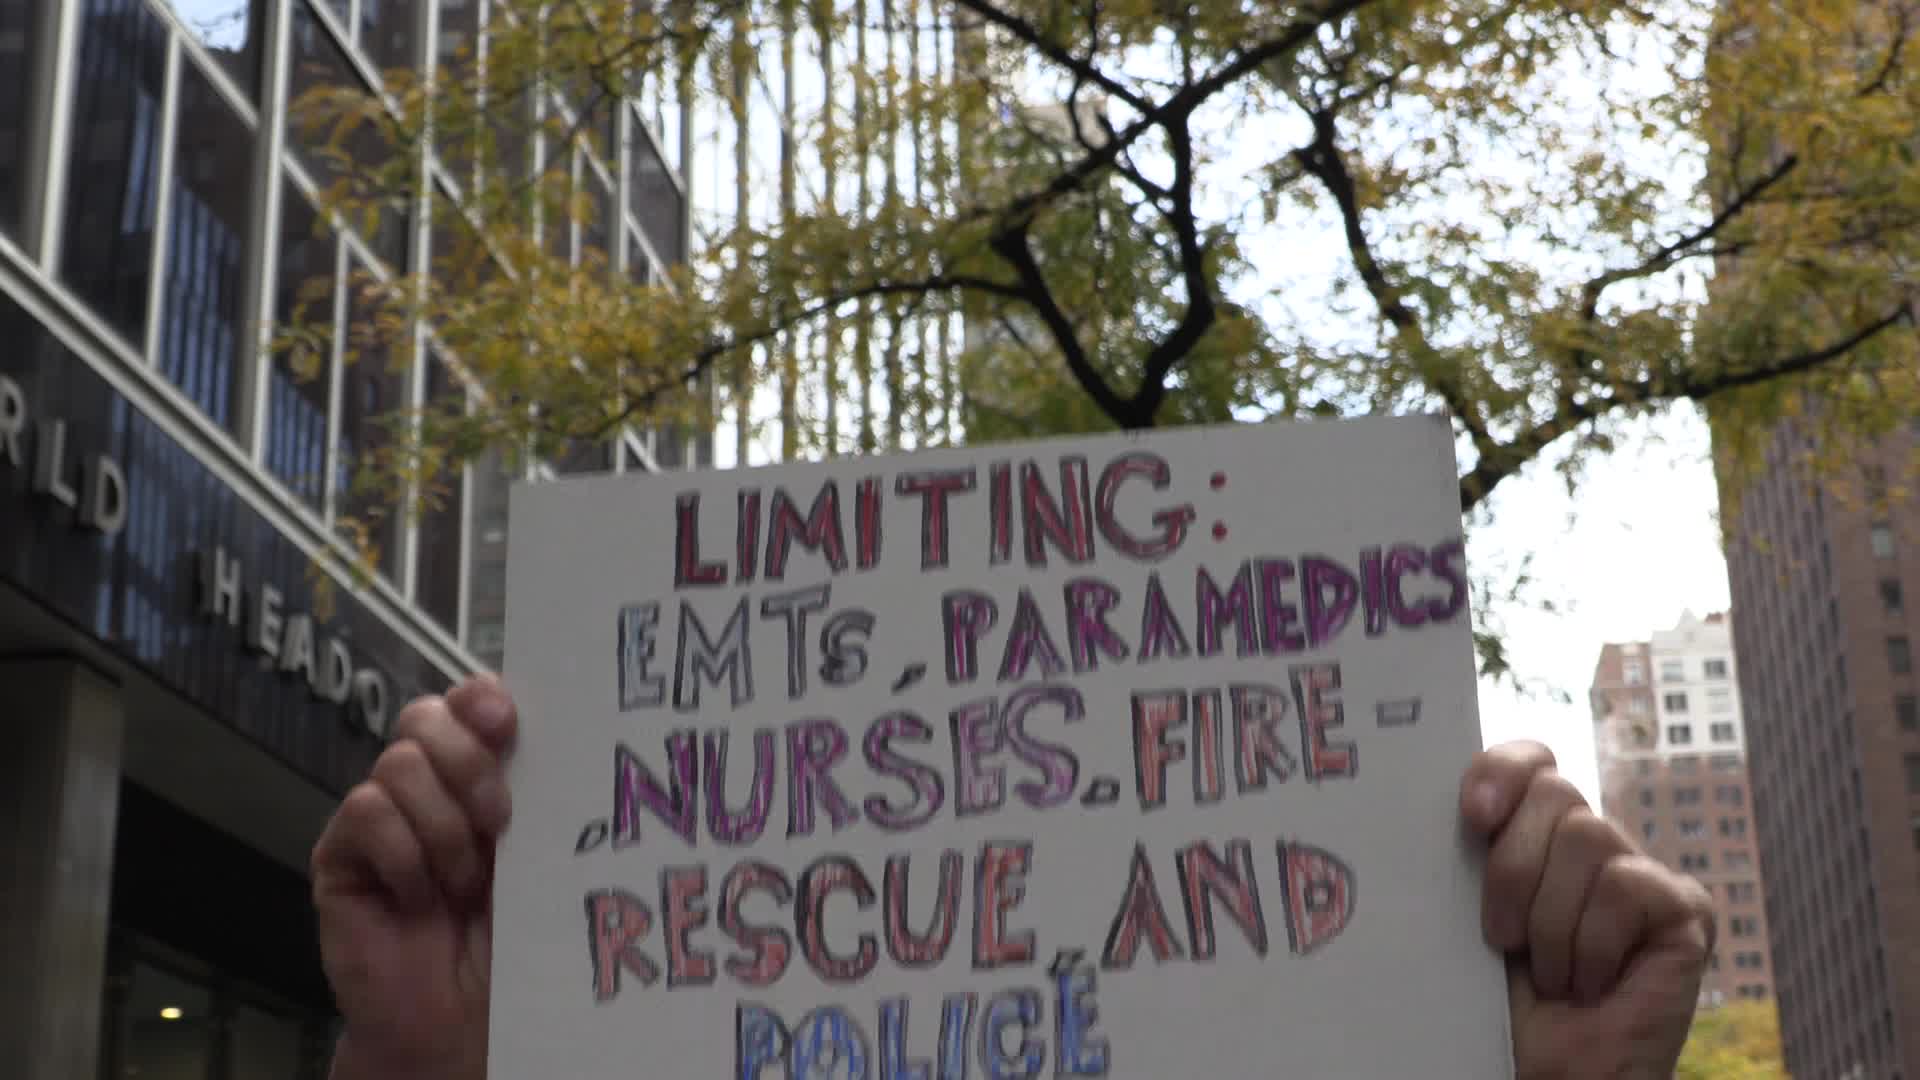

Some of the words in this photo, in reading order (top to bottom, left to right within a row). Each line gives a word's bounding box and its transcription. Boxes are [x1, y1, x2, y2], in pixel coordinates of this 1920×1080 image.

[674, 451, 1228, 590] LIMITING:
[941, 537, 1468, 684] PARAMEDICS
[1100, 835, 1358, 969] AND
[736, 964, 1110, 1080] POLICE
